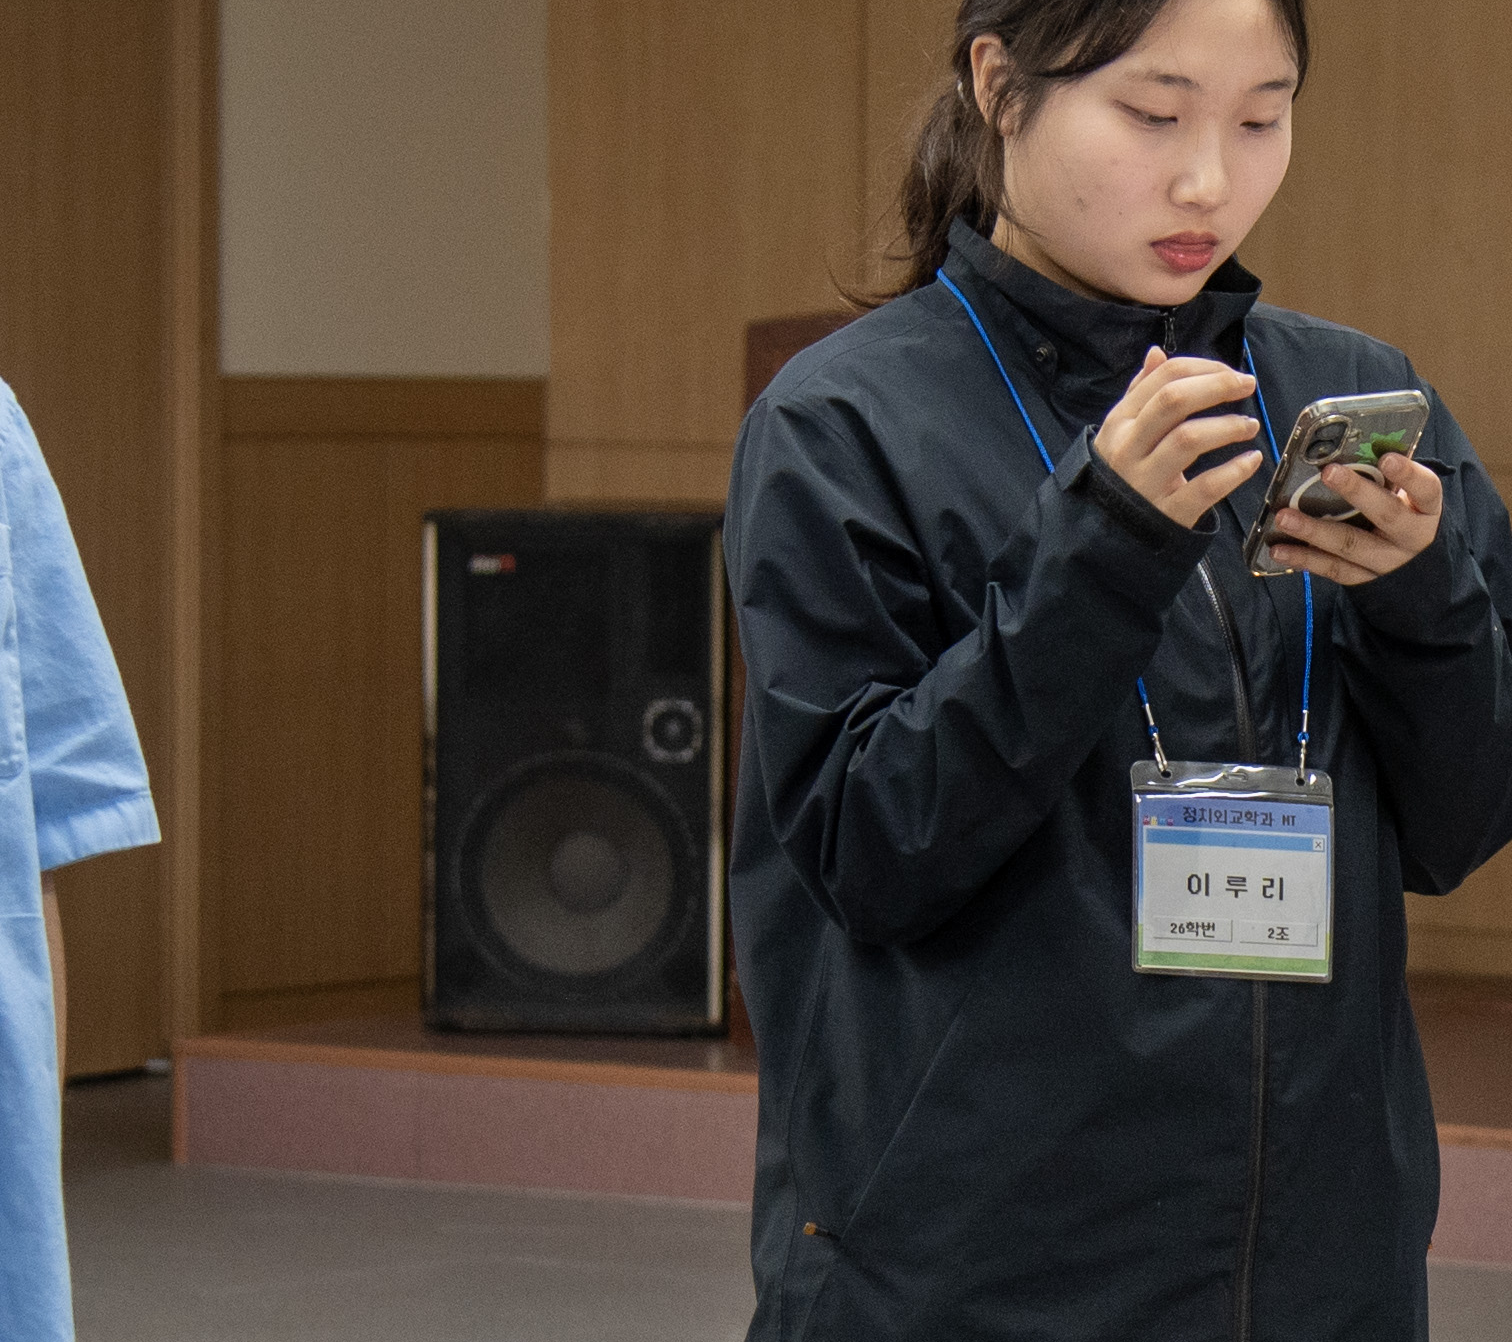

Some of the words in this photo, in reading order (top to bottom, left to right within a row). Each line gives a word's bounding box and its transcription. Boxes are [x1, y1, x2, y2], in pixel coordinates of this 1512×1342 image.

[1182, 806, 1276, 828] 정치외교학과
[1169, 921, 1217, 940] 26학번
[1267, 926, 1290, 942] 2조
